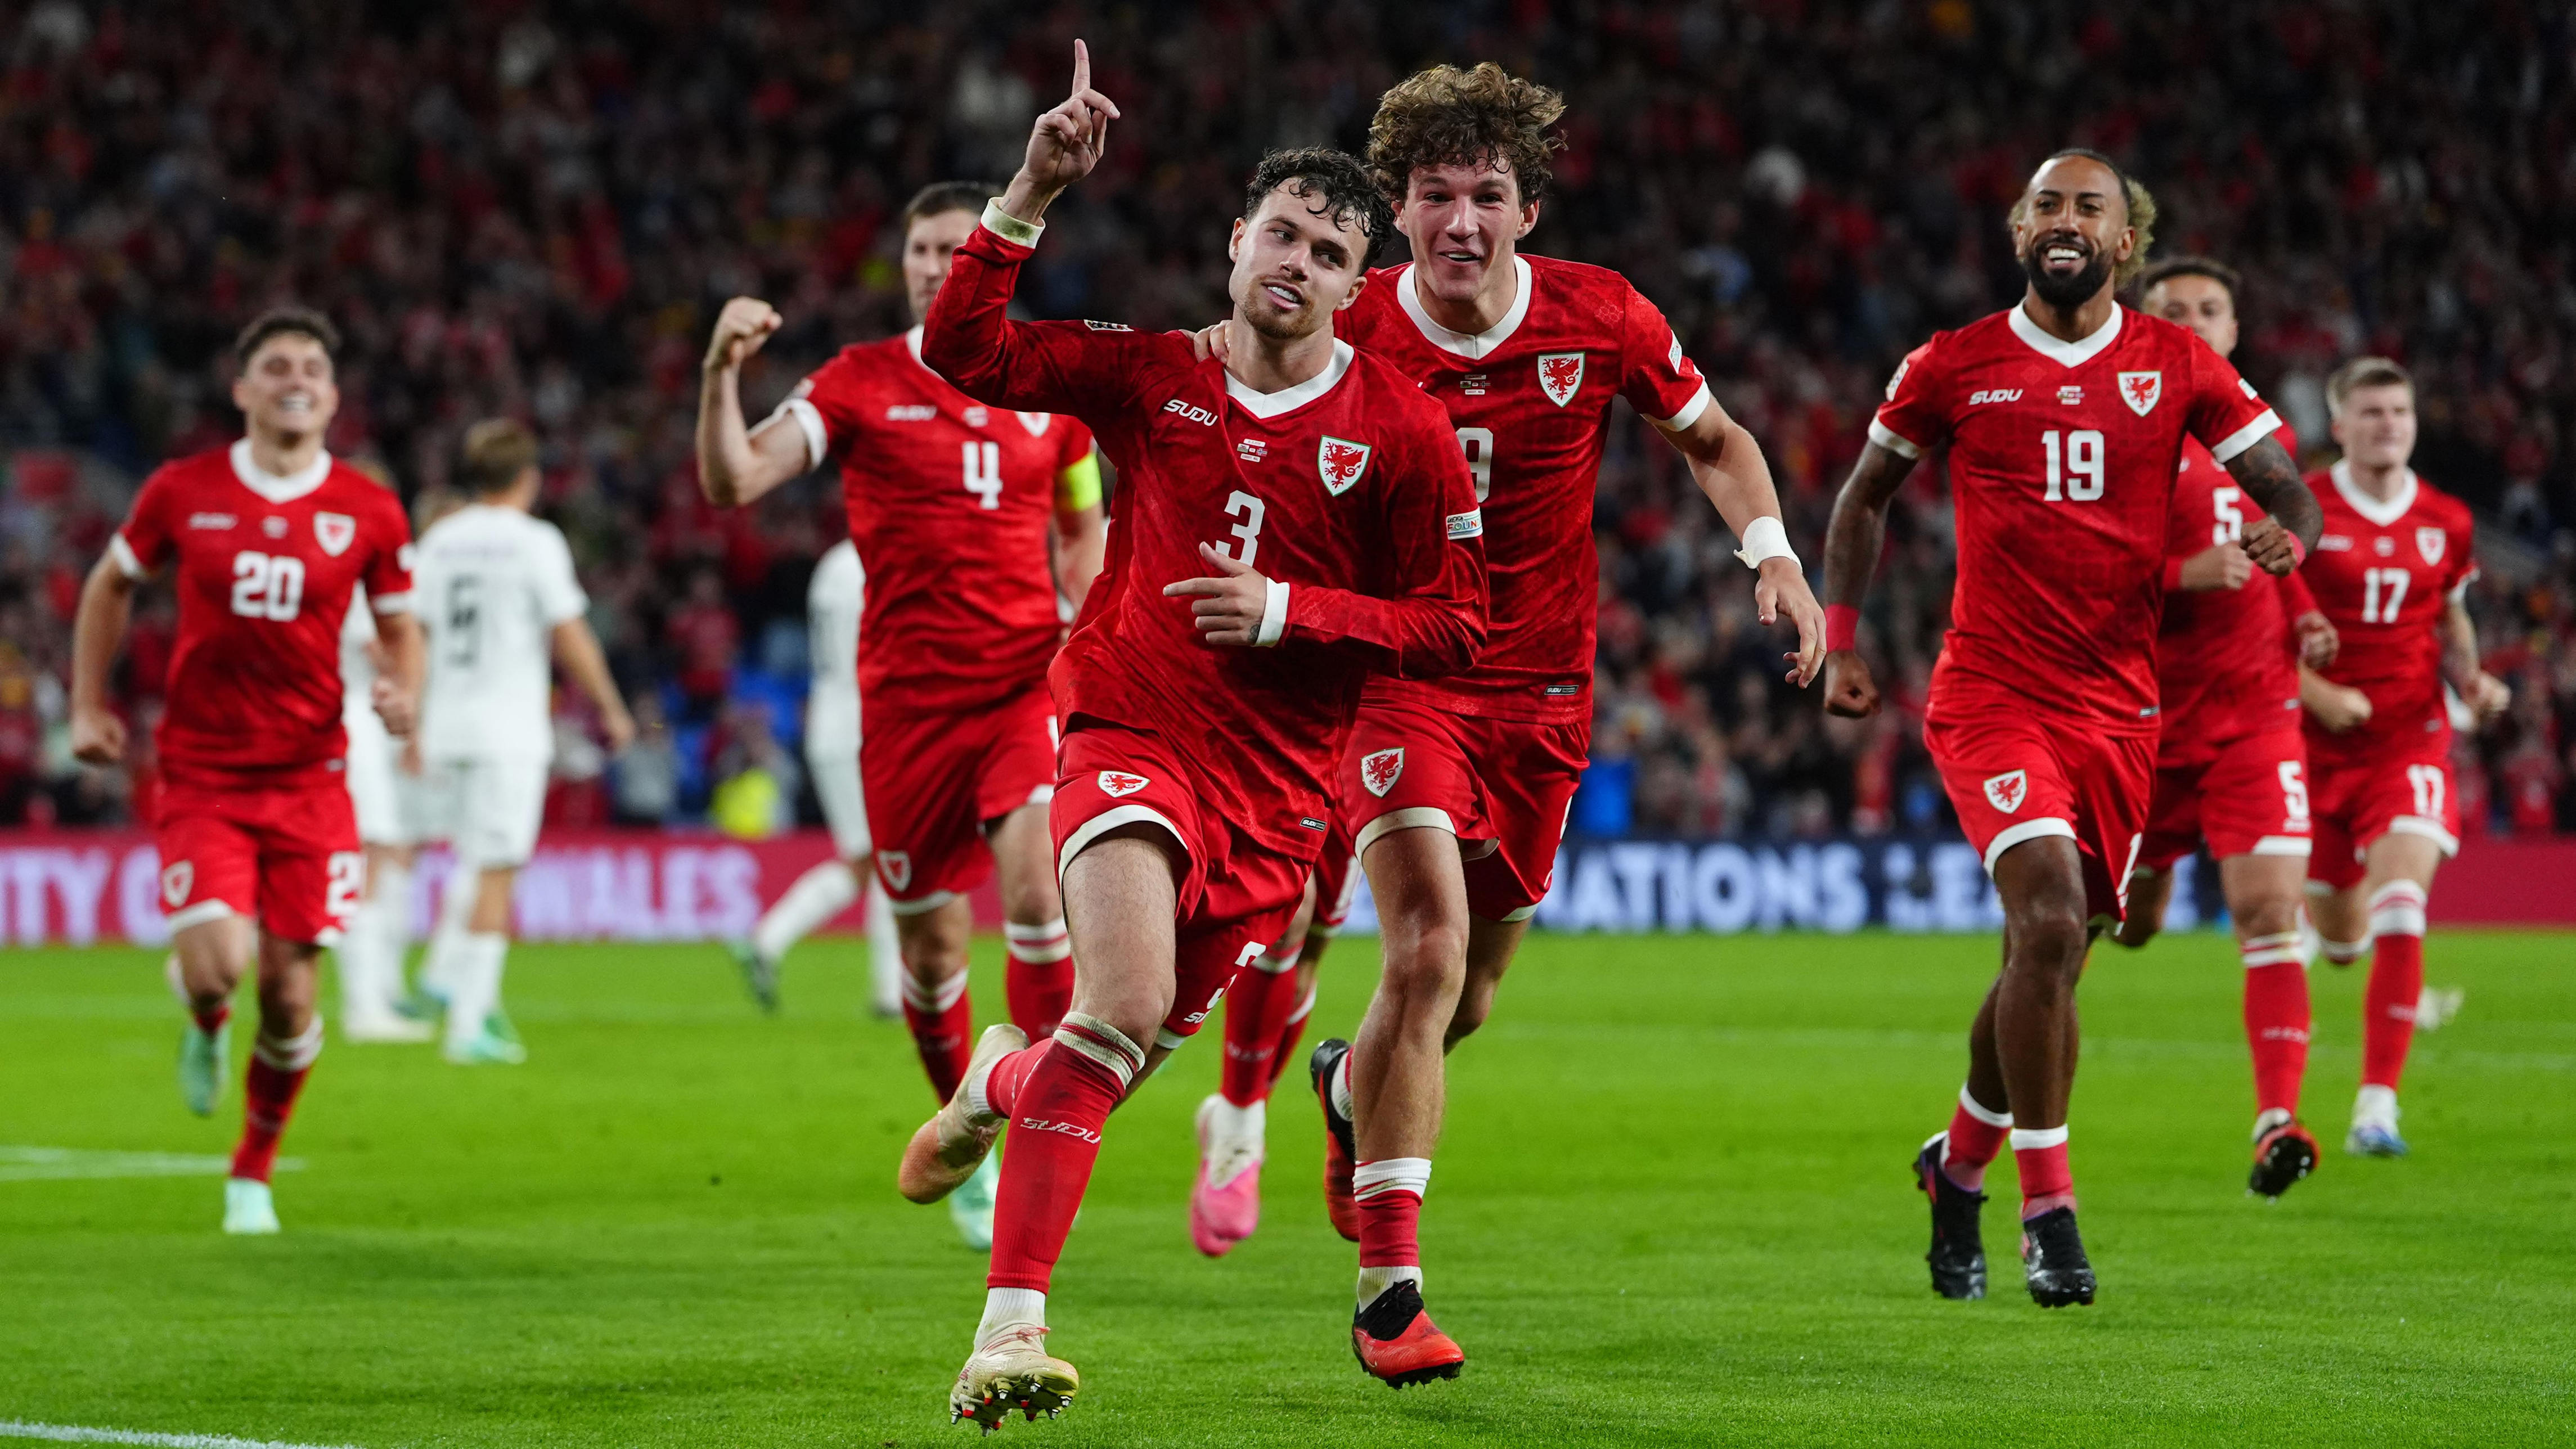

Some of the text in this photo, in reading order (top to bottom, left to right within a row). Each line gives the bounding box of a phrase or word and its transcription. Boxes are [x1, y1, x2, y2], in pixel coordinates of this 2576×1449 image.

[1163, 399, 1218, 426] SUDU
[1969, 389, 2024, 406] SUDU
[961, 441, 1002, 510] 4
[1455, 428, 1494, 503] 9
[2042, 430, 2105, 501] 19
[1215, 489, 1266, 568] 3
[2212, 487, 2244, 547] 5
[231, 550, 305, 622] 20
[2362, 567, 2411, 623] 17
[2278, 760, 2310, 819] 5
[1020, 1117, 1102, 1144] SUDU
